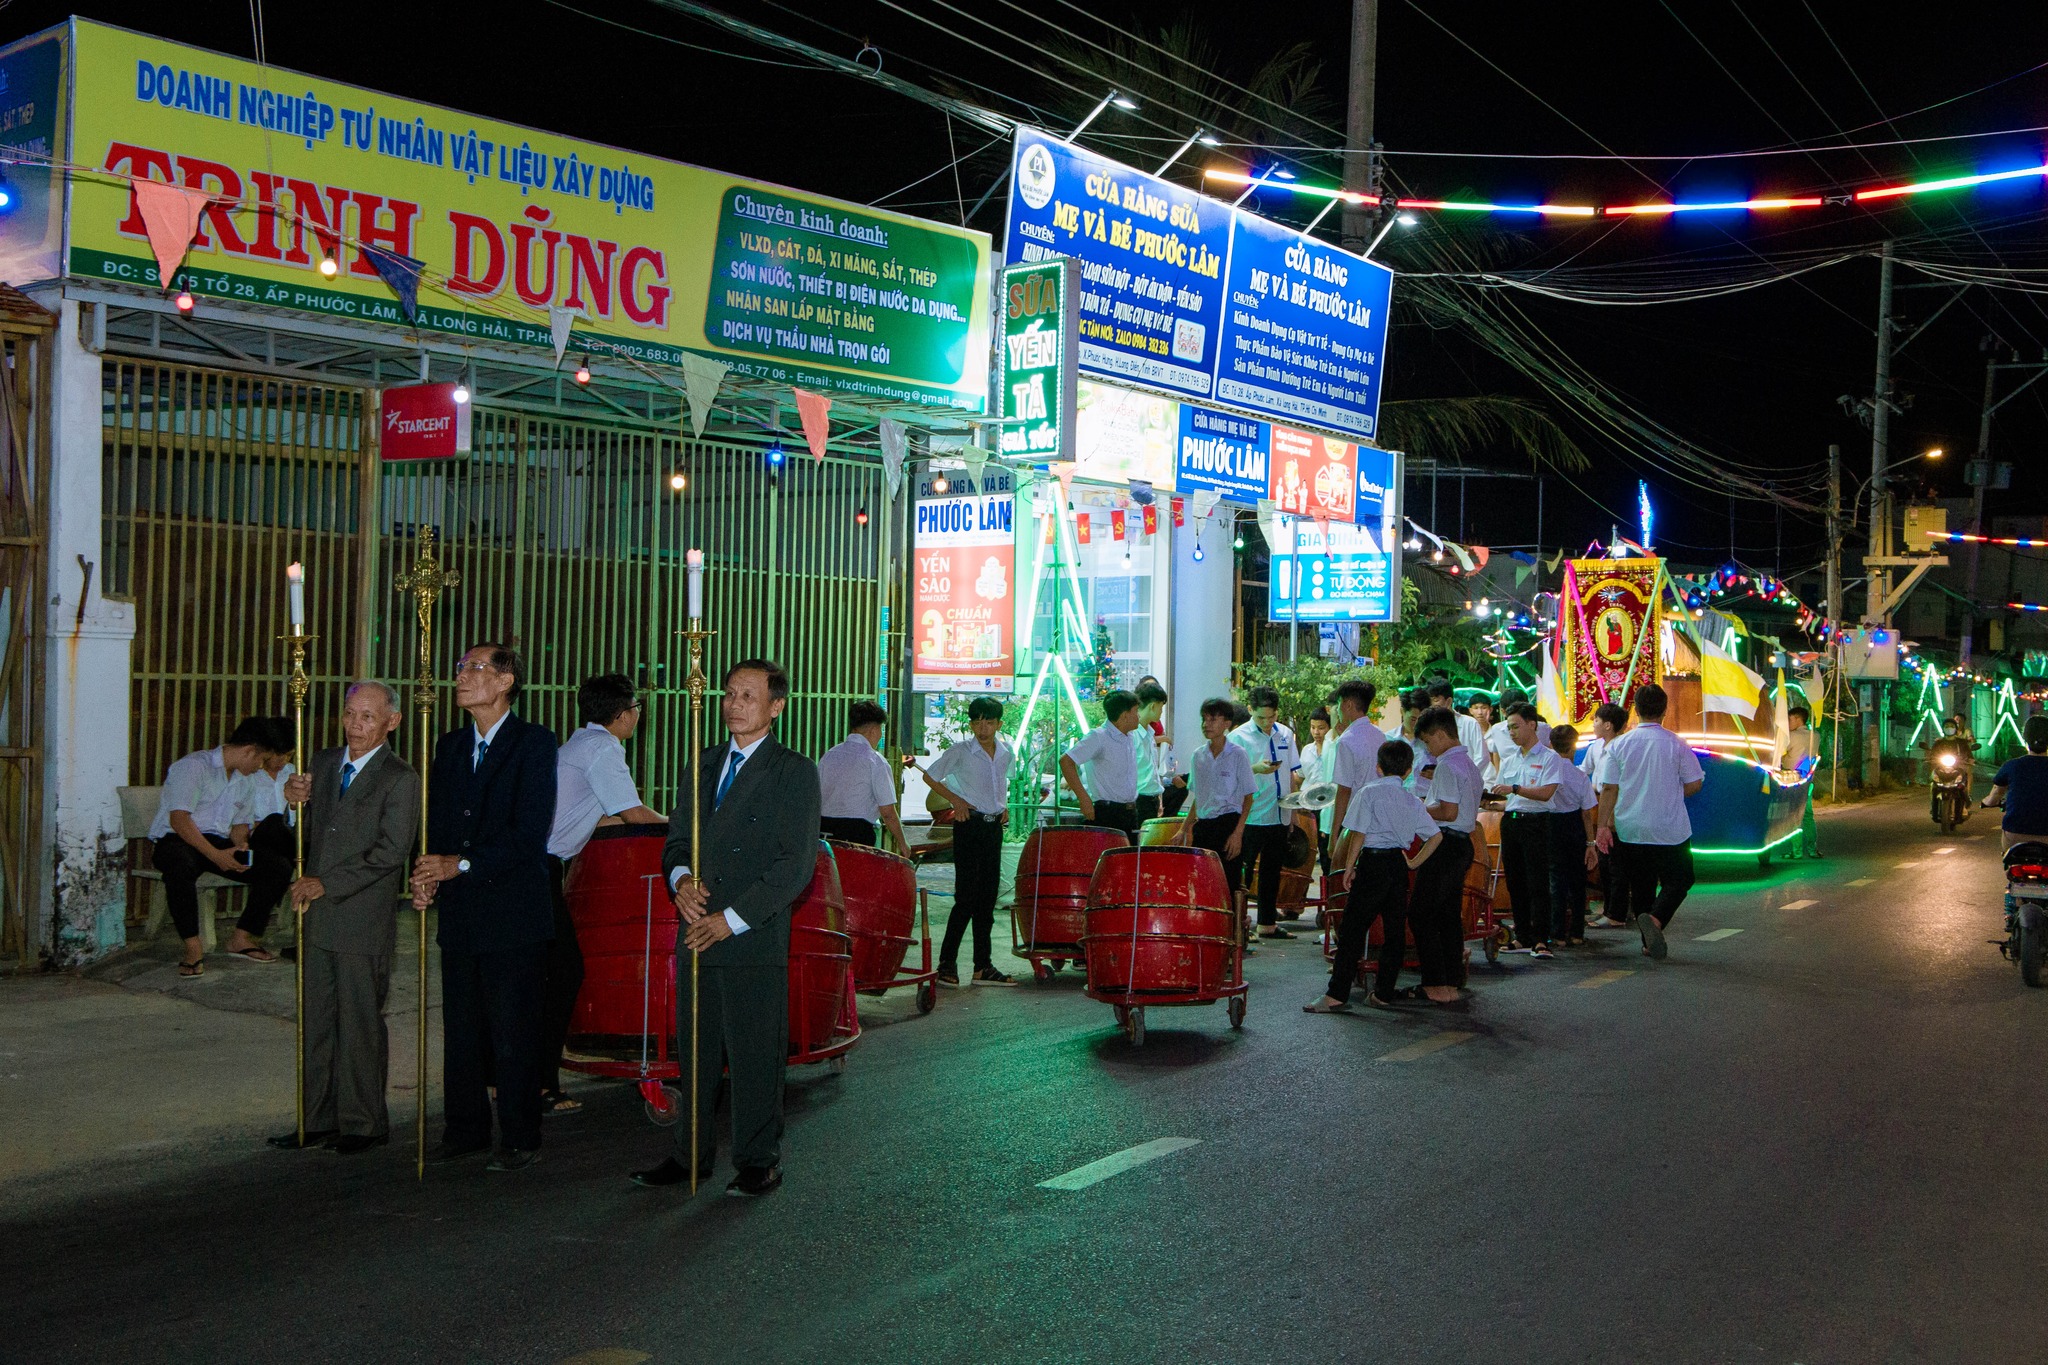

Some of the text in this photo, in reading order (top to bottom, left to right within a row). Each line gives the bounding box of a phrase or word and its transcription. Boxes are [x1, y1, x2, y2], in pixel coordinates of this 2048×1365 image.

[136, 59, 655, 216] DOANH NGHIỆP TƯ NHÂN VẬT LIỆU XÂY DỰNG
[734, 194, 889, 245] Chuyên kinh doanh:
[1084, 170, 1201, 235] CỬA HÀNG SỮA
[1020, 221, 1055, 243] CHUYÊN:
[1053, 200, 1221, 280] MẸ VÀ BÉ PHƯỚC LÂM
[447, 204, 672, 330] DŨNG
[740, 231, 938, 288] VLXD, CÁT, ĐÁ, XI MĂNG, SẮT, THÉP
[1021, 241, 1044, 263] KINH
[1114, 267, 1131, 294] BỘT
[1133, 273, 1149, 299] BỘT
[1284, 242, 1348, 287] CỬA HÀNG
[726, 288, 875, 333] NHẬN SAN LẤP MẶT BẰNG
[730, 264, 966, 324] SƠN NƯỚC, THIẾT BỊ ĐIỆN NƯỚC DA DỤNG...
[1008, 273, 1057, 319] SỮA
[1113, 302, 1134, 324] DỤNG
[1132, 307, 1144, 329] CỤ
[1233, 291, 1259, 309] CHUYÊN:
[1250, 268, 1371, 329] MẸ VÀ BÉ PHƯỚC LÂM
[103, 260, 974, 410] ĐC: 05 TỔ 28, ẤP PHƯỚC LÂM, LONG HẢI, 77 06 Email: vlxdtrinhdung@gmail.com
[723, 319, 891, 365] DỊCH VỤ THẦU NHÀ TRỌN GÓI
[1007, 318, 1057, 371] YẾN
[1087, 319, 1101, 340] TẬN
[1115, 329, 1132, 346] ZALO
[1250, 315, 1270, 333] Doanh
[1271, 321, 1287, 341] Dụng
[397, 416, 451, 434] STARCEMT
[1002, 421, 1056, 452] GIÁ TỐT
[1194, 411, 1208, 429] CỬA
[1209, 415, 1227, 433] HÀNG
[1228, 420, 1238, 438] MẸ
[1239, 421, 1248, 437] VÀ
[1248, 424, 1257, 439] BÉ
[1182, 436, 1235, 476] PHƯỚC
[1235, 443, 1266, 482] LÂM
[984, 472, 1010, 492] VÀ BÉ
[918, 496, 1012, 533] PHƯỚC LÂM
[920, 550, 950, 574] YẾN
[1297, 533, 1322, 547] GIA
[919, 573, 951, 593] SÀO
[1330, 574, 1386, 590] TỰ ĐỘNG
[920, 609, 944, 657] 3
[946, 604, 992, 619] CHUẨN
